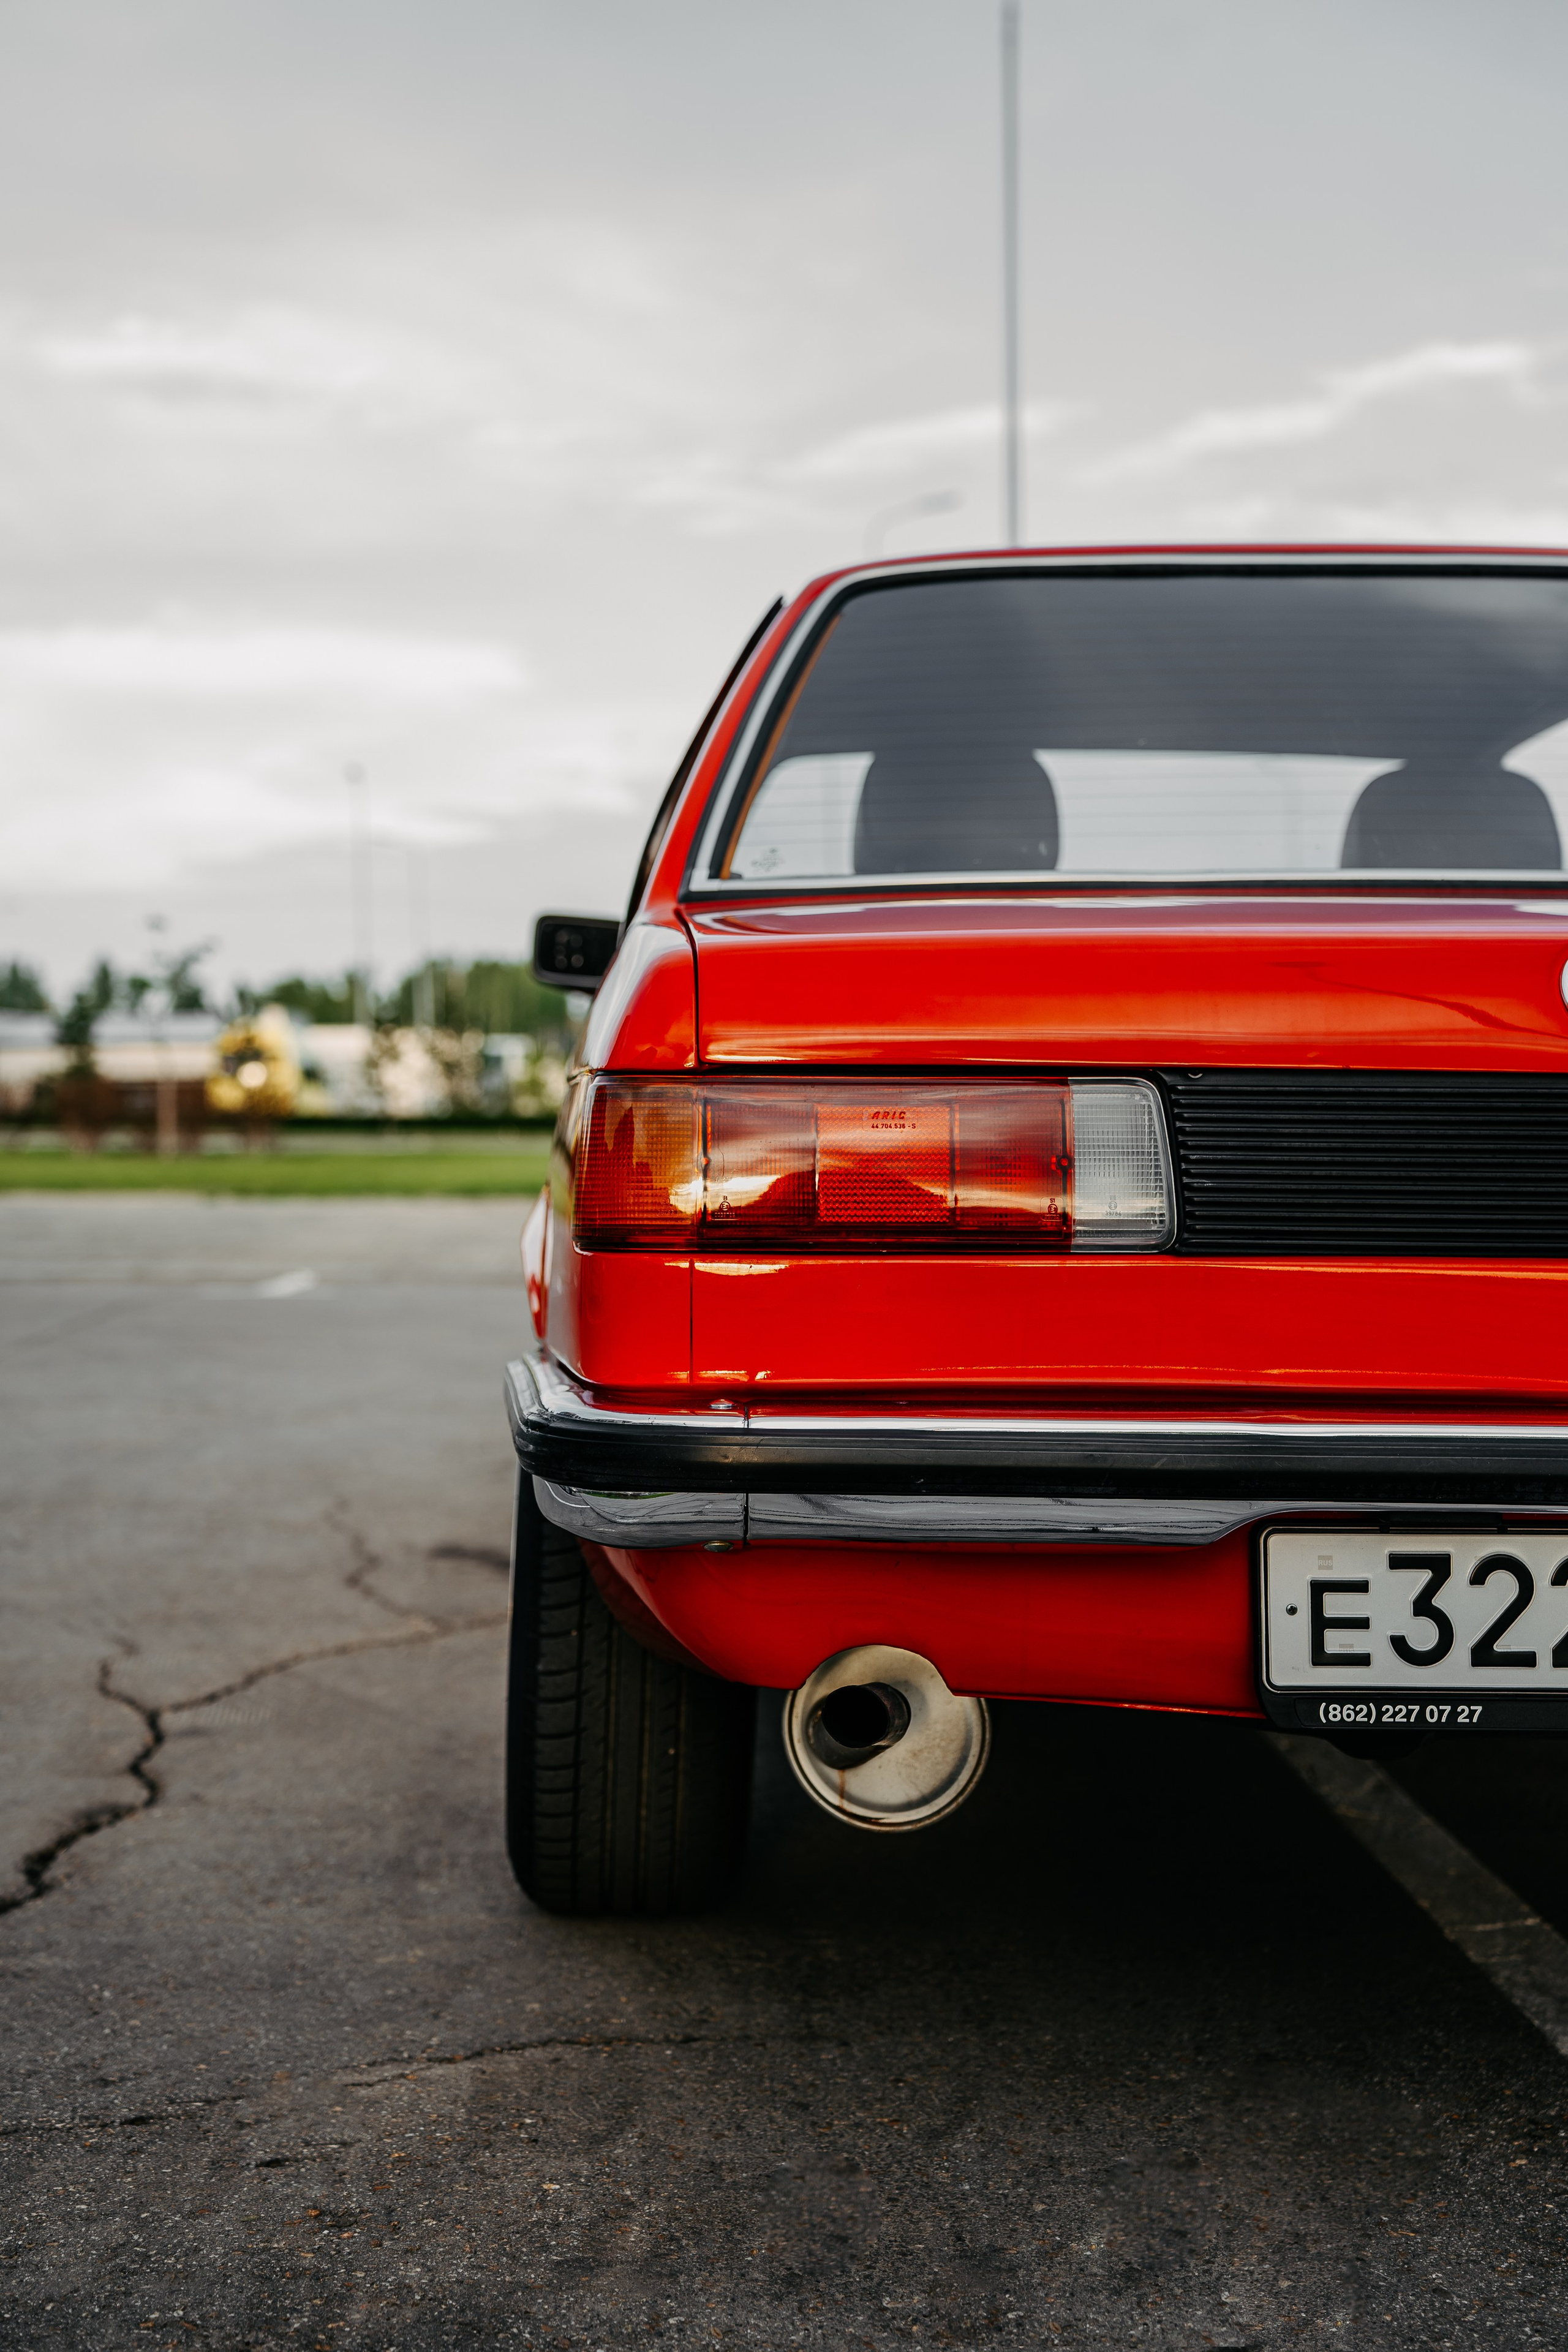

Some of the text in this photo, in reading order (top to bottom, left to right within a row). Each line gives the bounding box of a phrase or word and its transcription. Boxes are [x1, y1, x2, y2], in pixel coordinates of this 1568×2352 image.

[872, 1111, 906, 1120] ARIC
[1310, 1553, 1568, 1668] E32
[1319, 1702, 1483, 1724] (862) 227 07 27
